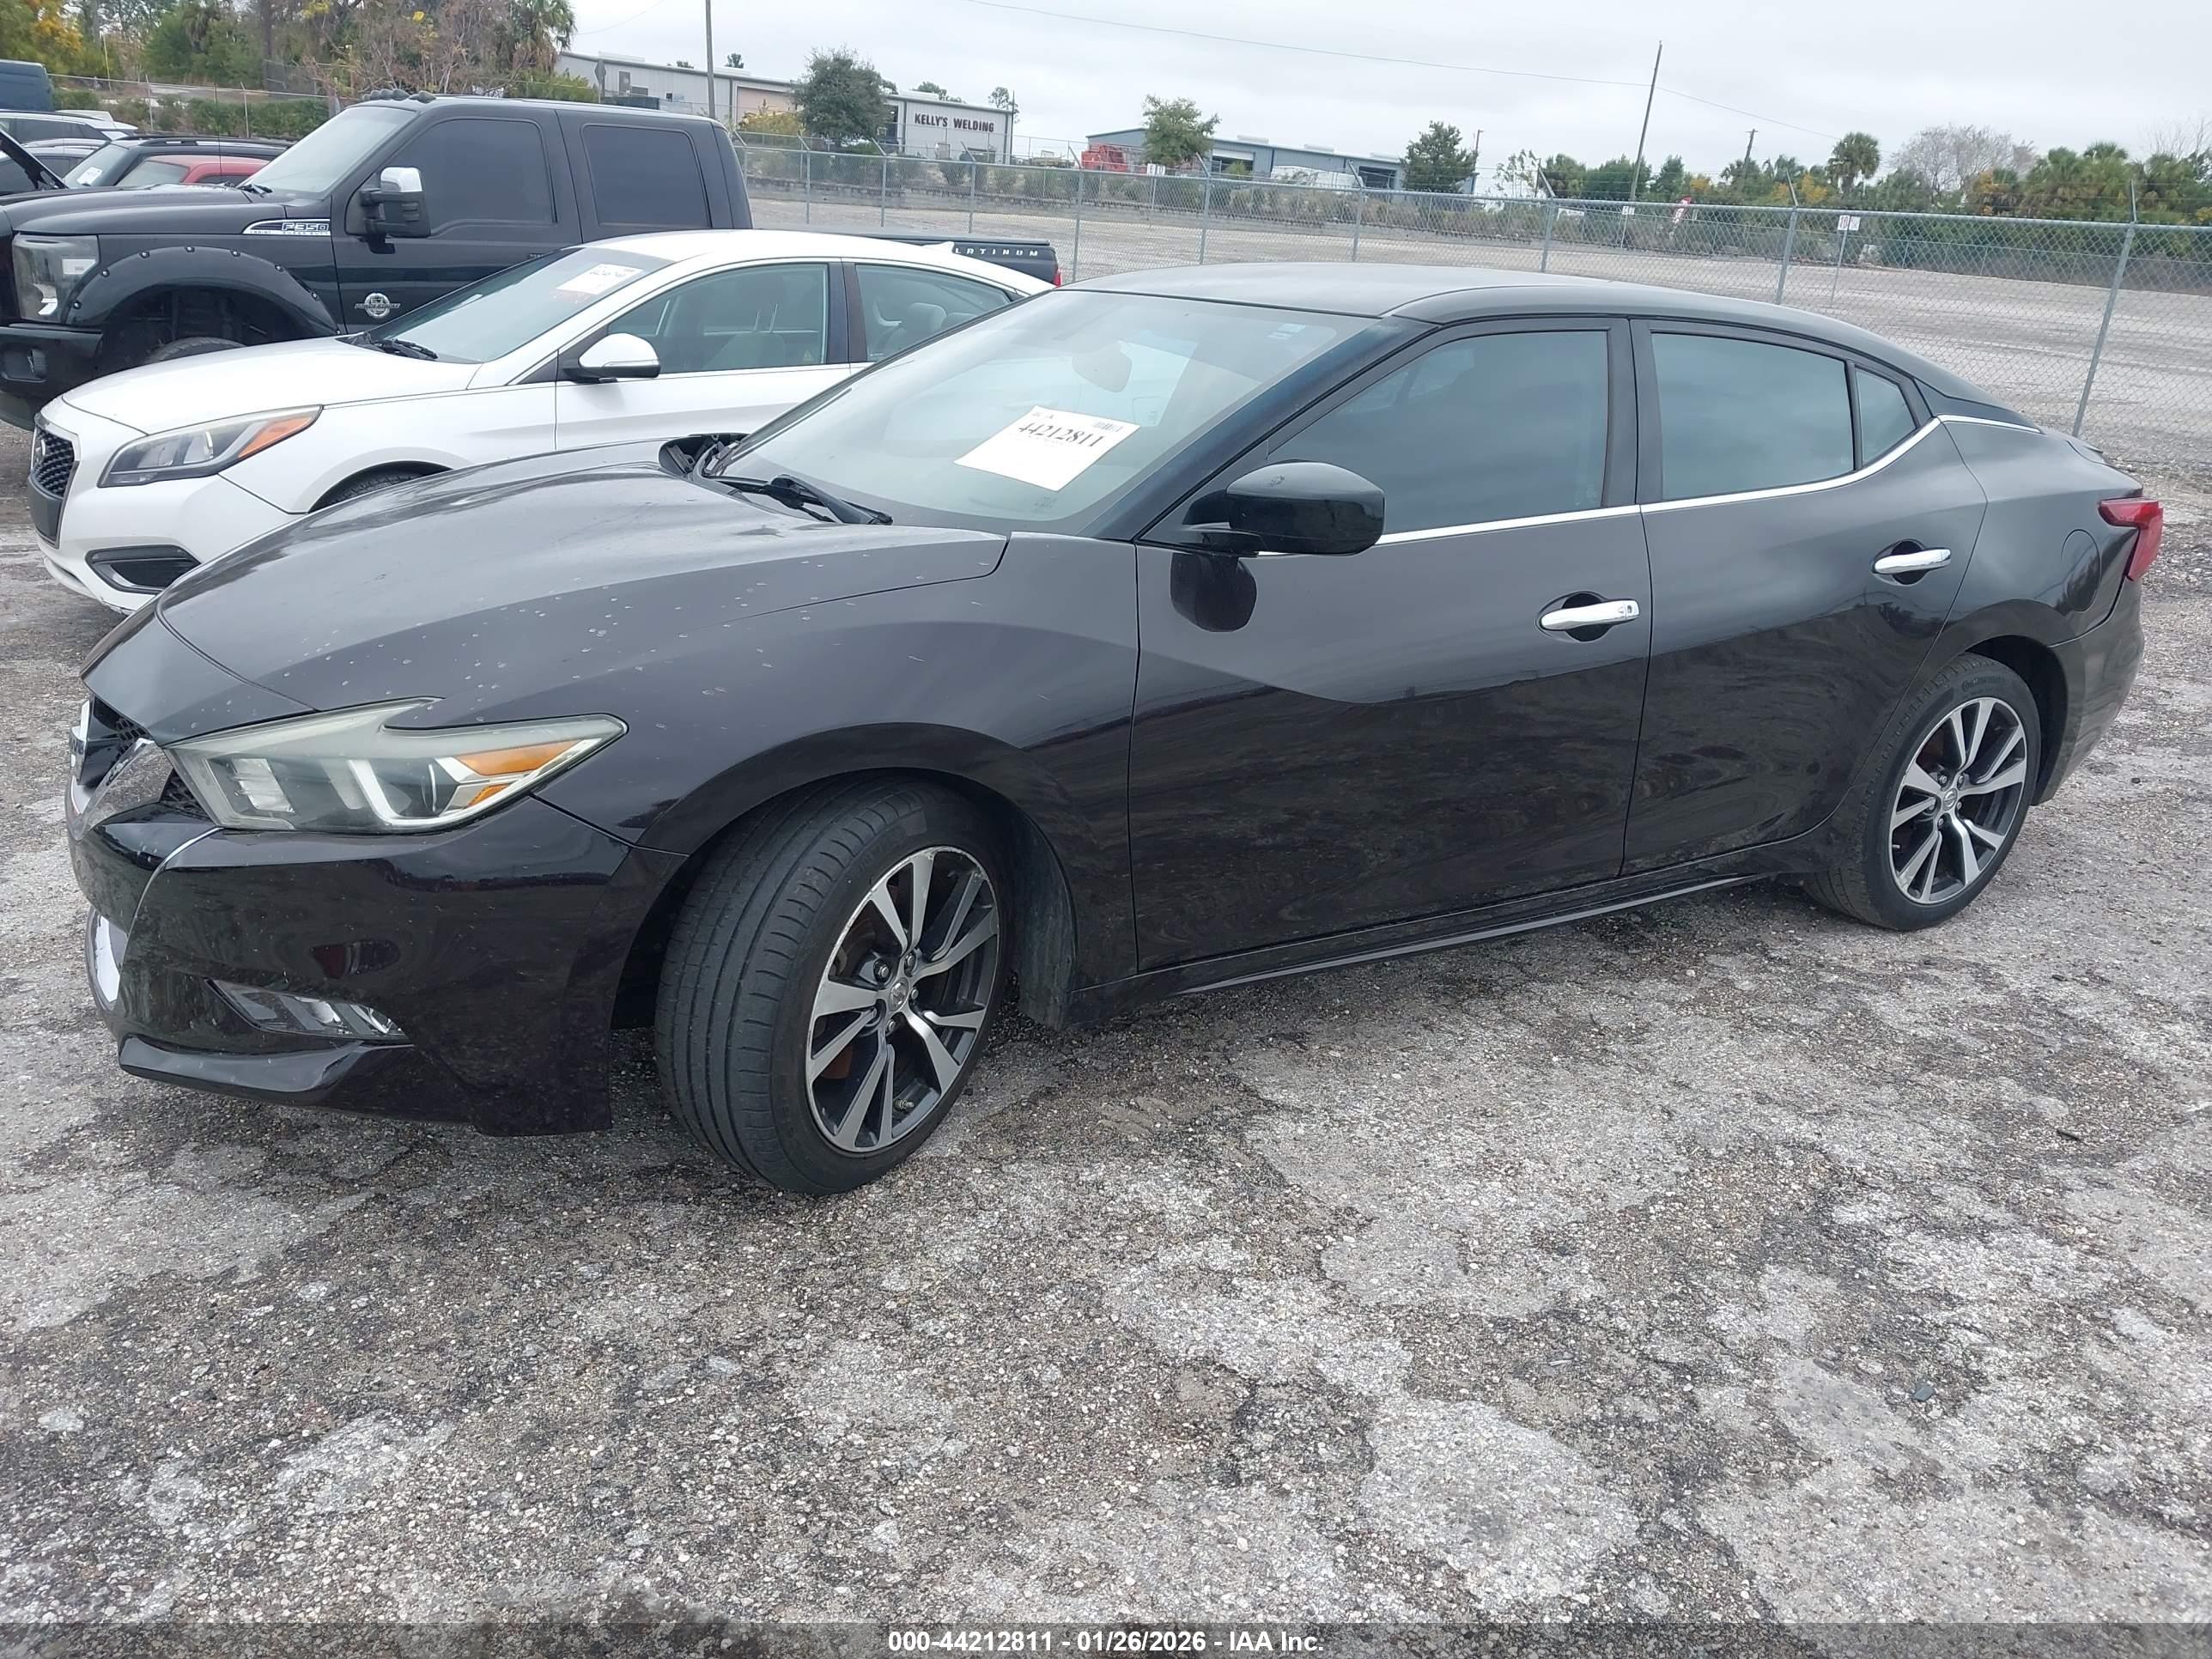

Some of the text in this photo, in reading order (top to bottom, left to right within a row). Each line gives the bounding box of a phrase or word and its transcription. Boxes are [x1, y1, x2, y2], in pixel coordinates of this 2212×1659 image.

[915, 112, 994, 133] KELLY'S WELDING
[955, 247, 1038, 257] LATINUM
[1018, 422, 1105, 447] 44212811
